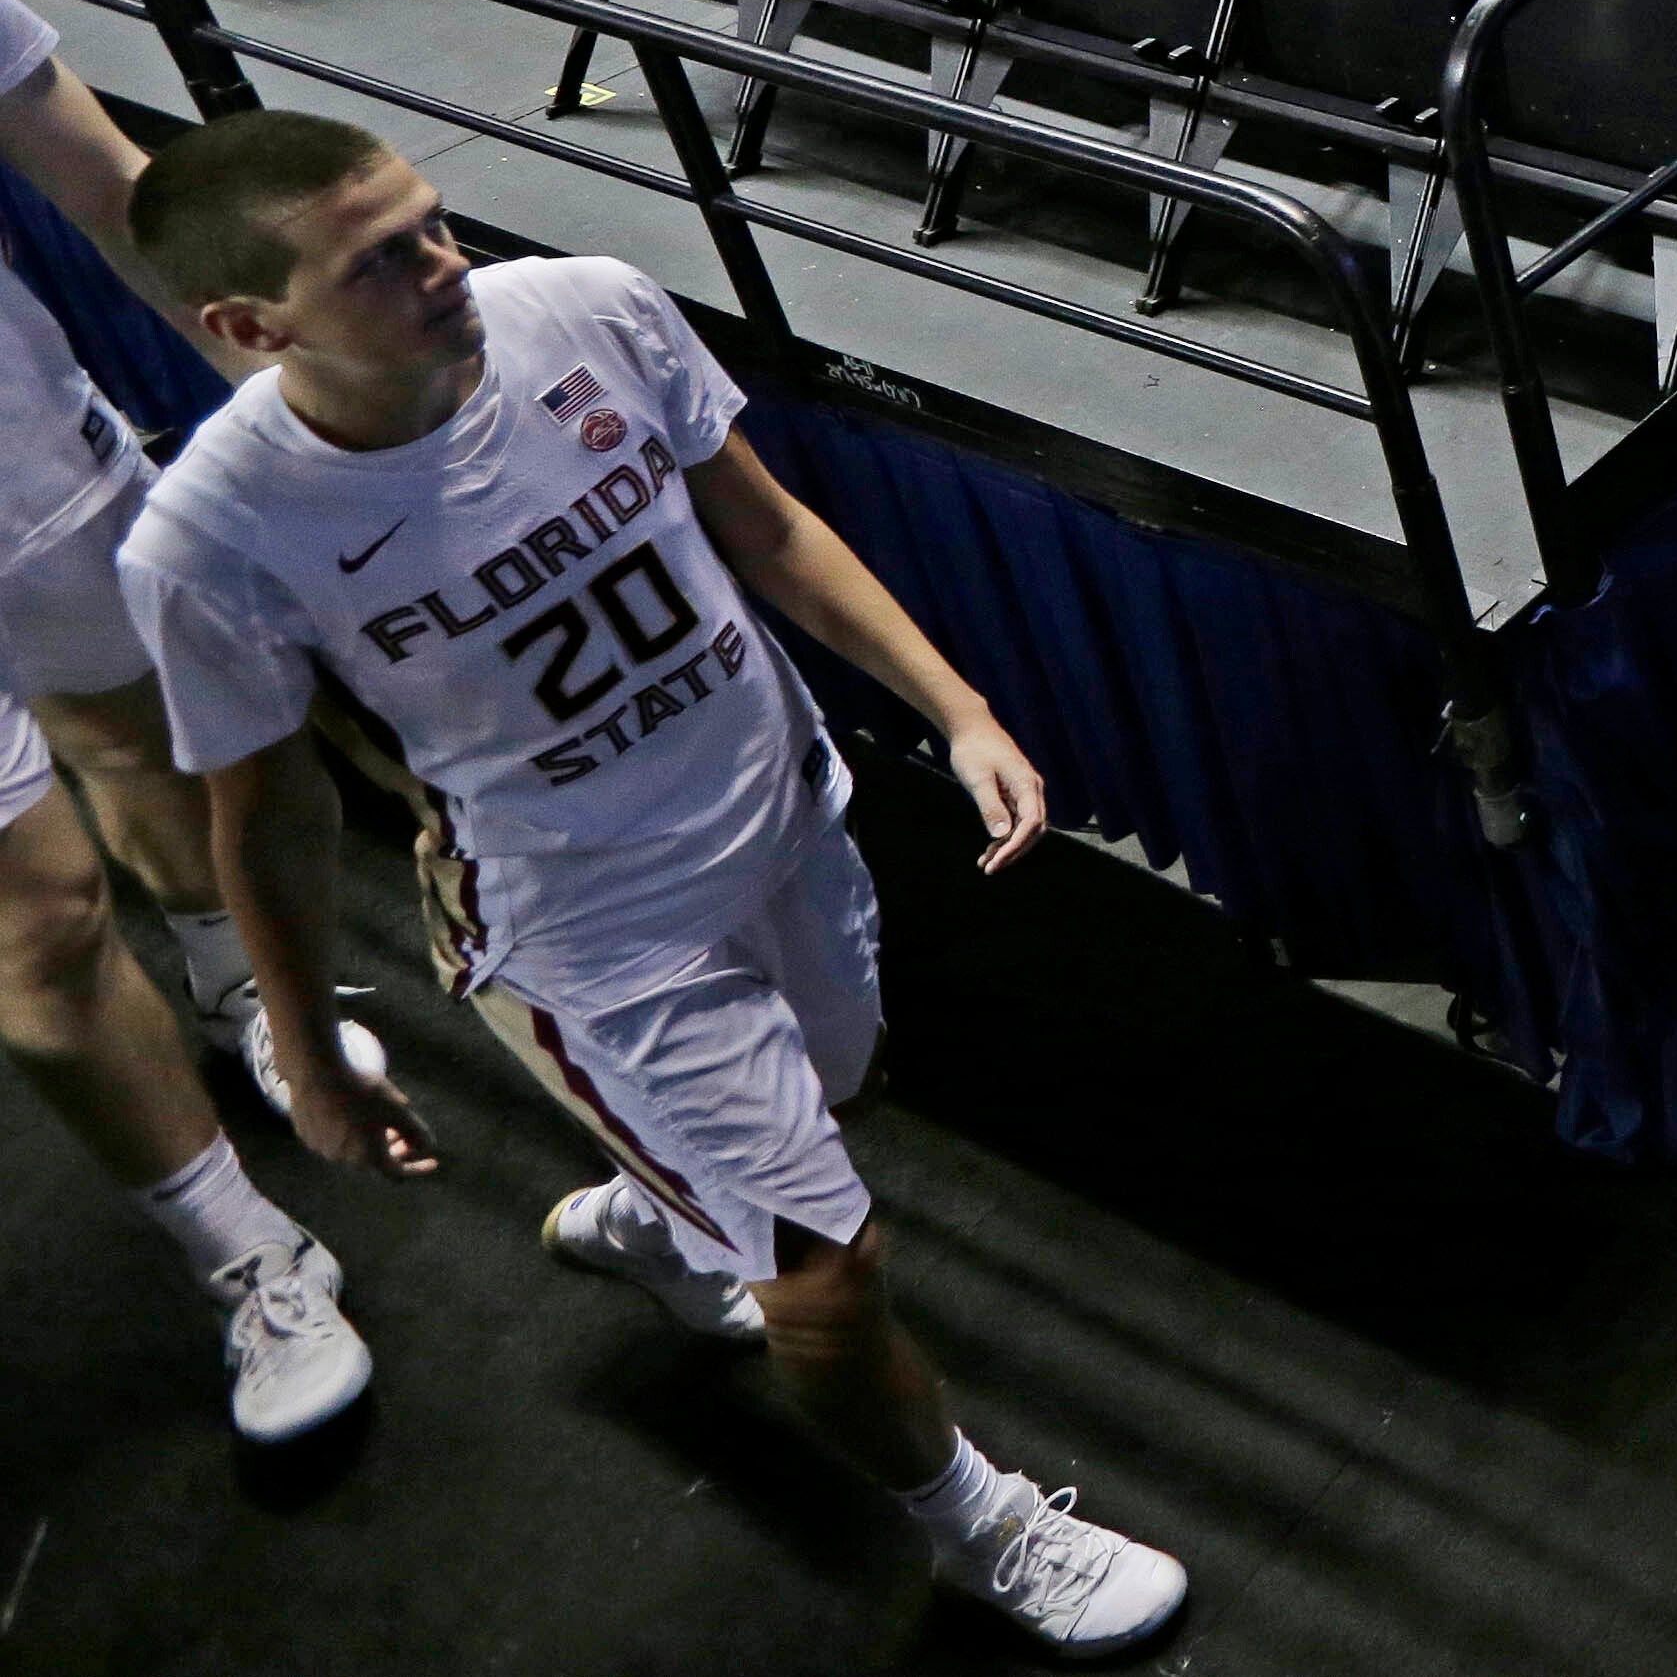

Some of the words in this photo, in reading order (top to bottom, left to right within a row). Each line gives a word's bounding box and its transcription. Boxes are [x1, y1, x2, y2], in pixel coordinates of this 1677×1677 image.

[360, 436, 676, 664] FLORIDA
[502, 539, 700, 723] 20
[529, 620, 746, 786] STATE
